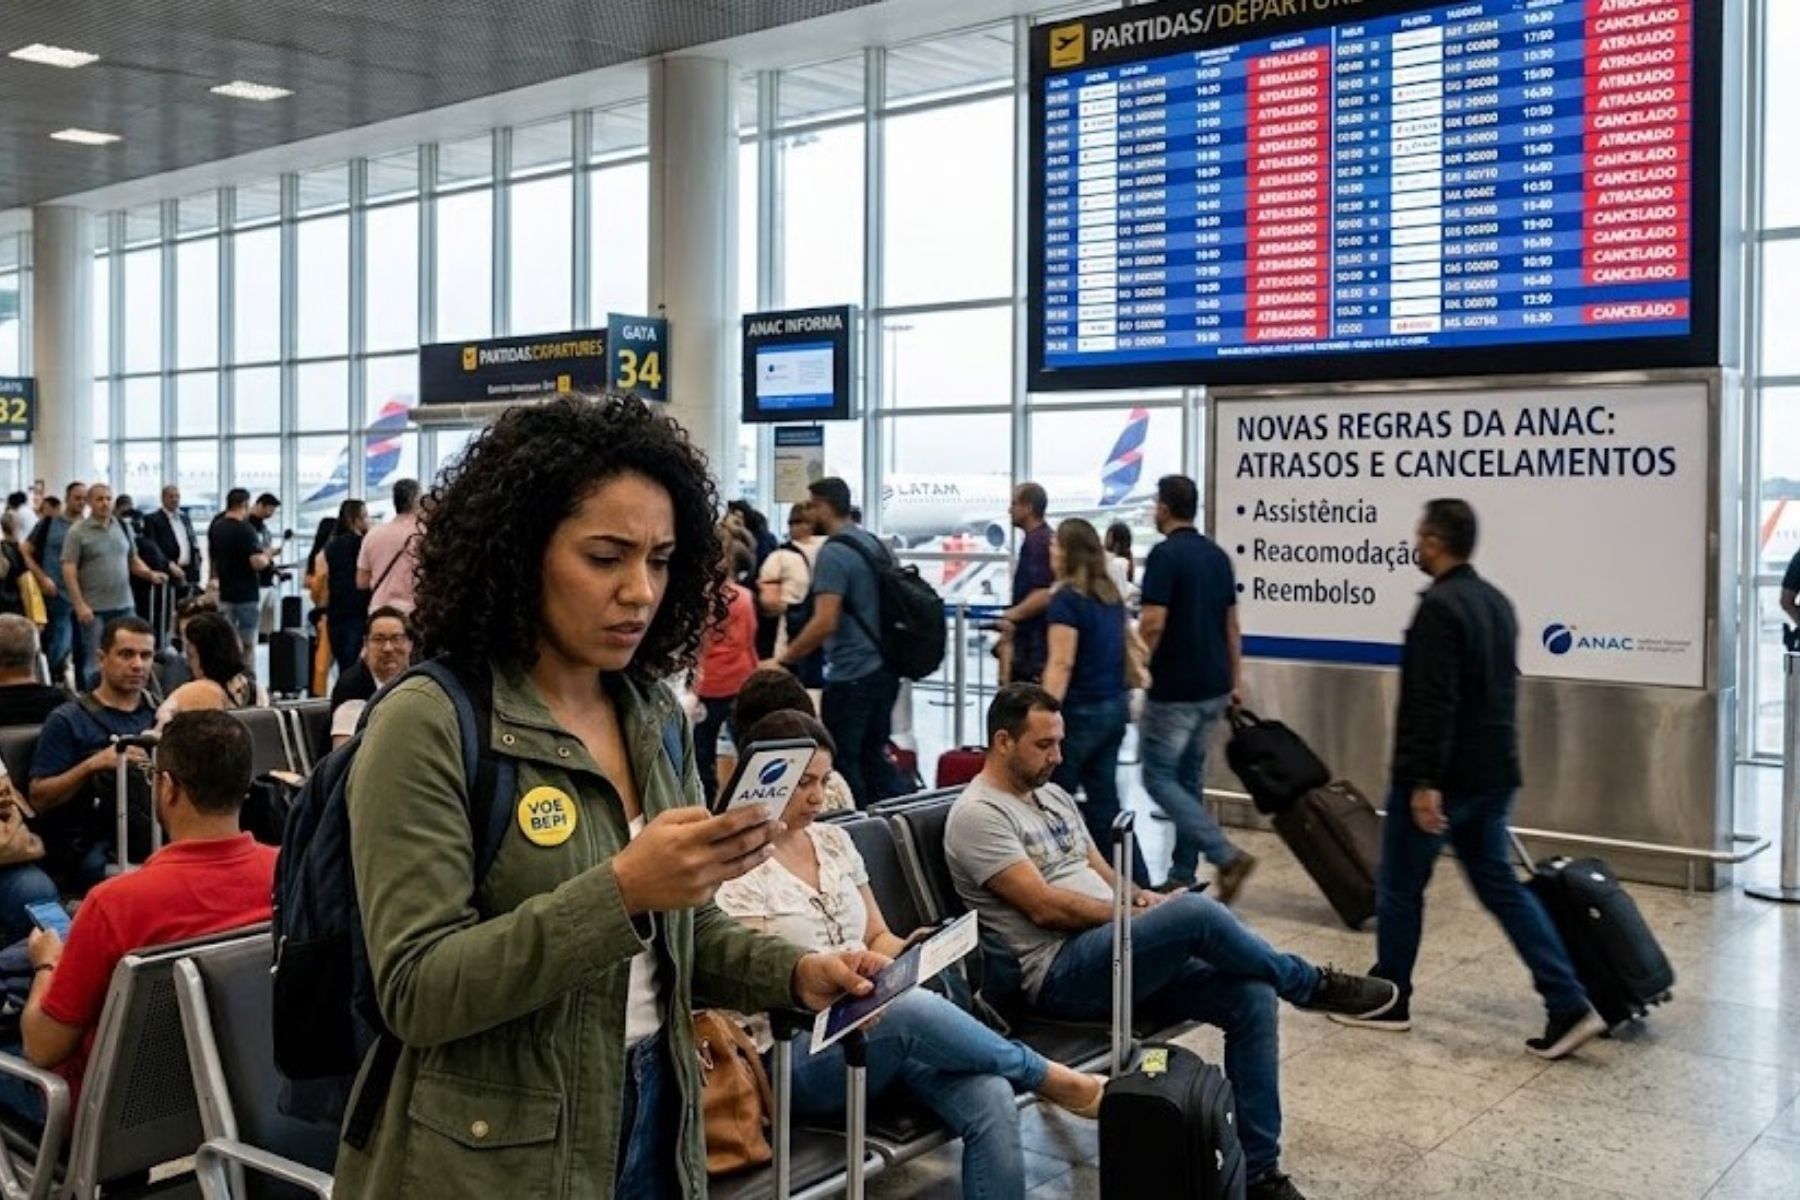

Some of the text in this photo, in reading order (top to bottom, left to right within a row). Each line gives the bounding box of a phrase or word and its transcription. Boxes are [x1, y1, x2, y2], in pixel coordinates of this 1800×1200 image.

[1091, 0, 1363, 51] PARTIDAS/DEPART
[1595, 8, 1679, 33] CANCELADO
[1593, 106, 1678, 128] CANCELADO
[1593, 166, 1677, 187] CANCELADO
[1593, 205, 1677, 225] CANCELADO
[1593, 225, 1677, 244] CANCELADO
[1593, 244, 1677, 263] CANCELADO
[1593, 264, 1677, 282] CANCELADO
[1593, 303, 1676, 320] CANCELADO
[622, 325, 656, 341] GATA
[748, 314, 843, 337] ANAC INFORMA
[616, 349, 661, 390] 34
[1237, 406, 1615, 441] NOVAS REGRAS DA ANAC:
[1236, 446, 1676, 478] ATRASOS E CANCELAMENTOS
[1253, 498, 1378, 524] Assistência
[1253, 577, 1376, 605] Reembolso
[1577, 636, 1634, 650] ANAC
[738, 786, 788, 801] ANAC
[527, 799, 564, 815] VOE
